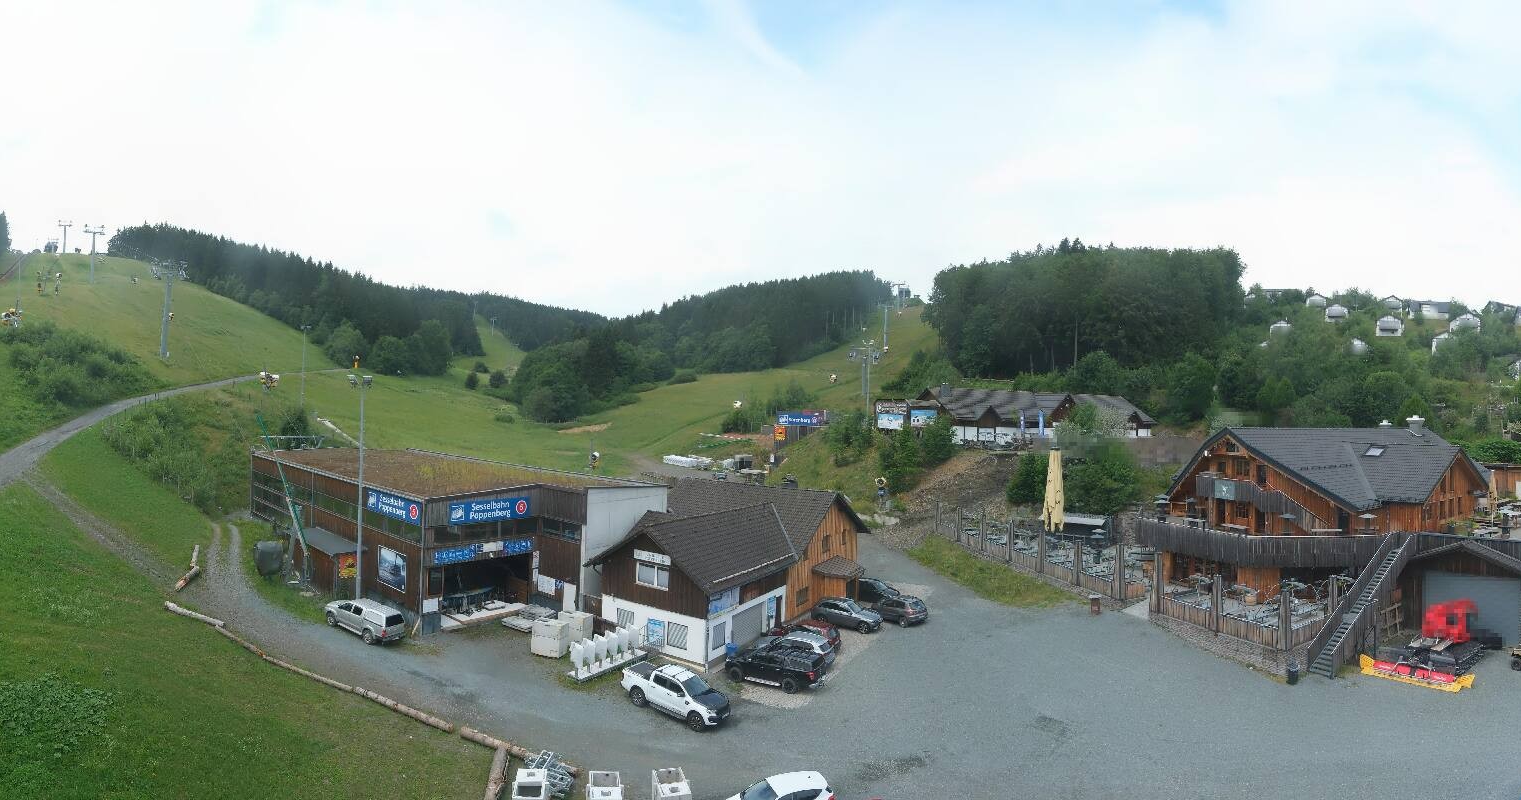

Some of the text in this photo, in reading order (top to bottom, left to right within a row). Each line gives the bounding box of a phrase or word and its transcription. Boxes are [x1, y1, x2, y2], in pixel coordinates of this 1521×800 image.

[379, 494, 405, 507] Sesselbahn
[471, 501, 510, 511] Sesselbahn
[378, 501, 406, 519] Poppenberg
[469, 509, 511, 520] Poppenberg
